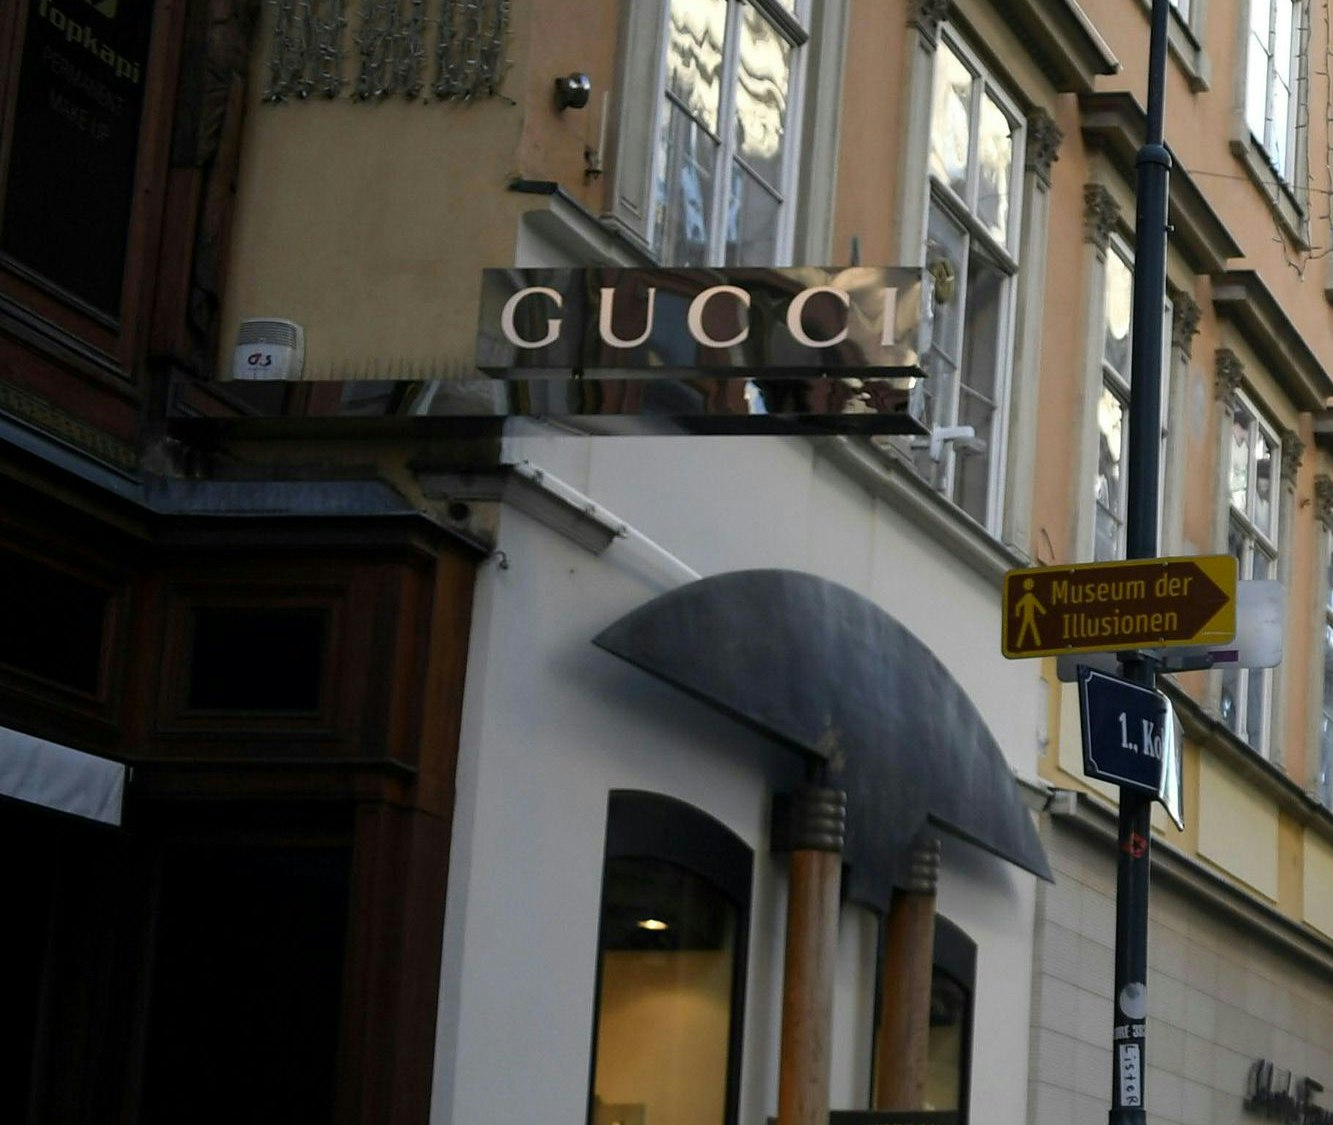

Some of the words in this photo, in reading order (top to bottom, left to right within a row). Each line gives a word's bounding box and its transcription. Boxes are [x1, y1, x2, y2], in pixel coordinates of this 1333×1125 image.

[500, 285, 898, 350] GUCCI
[1052, 579, 1145, 604] Museum
[1155, 572, 1193, 599] der
[1062, 609, 1177, 638] Illusionen
[1118, 711, 1139, 754] 1.,
